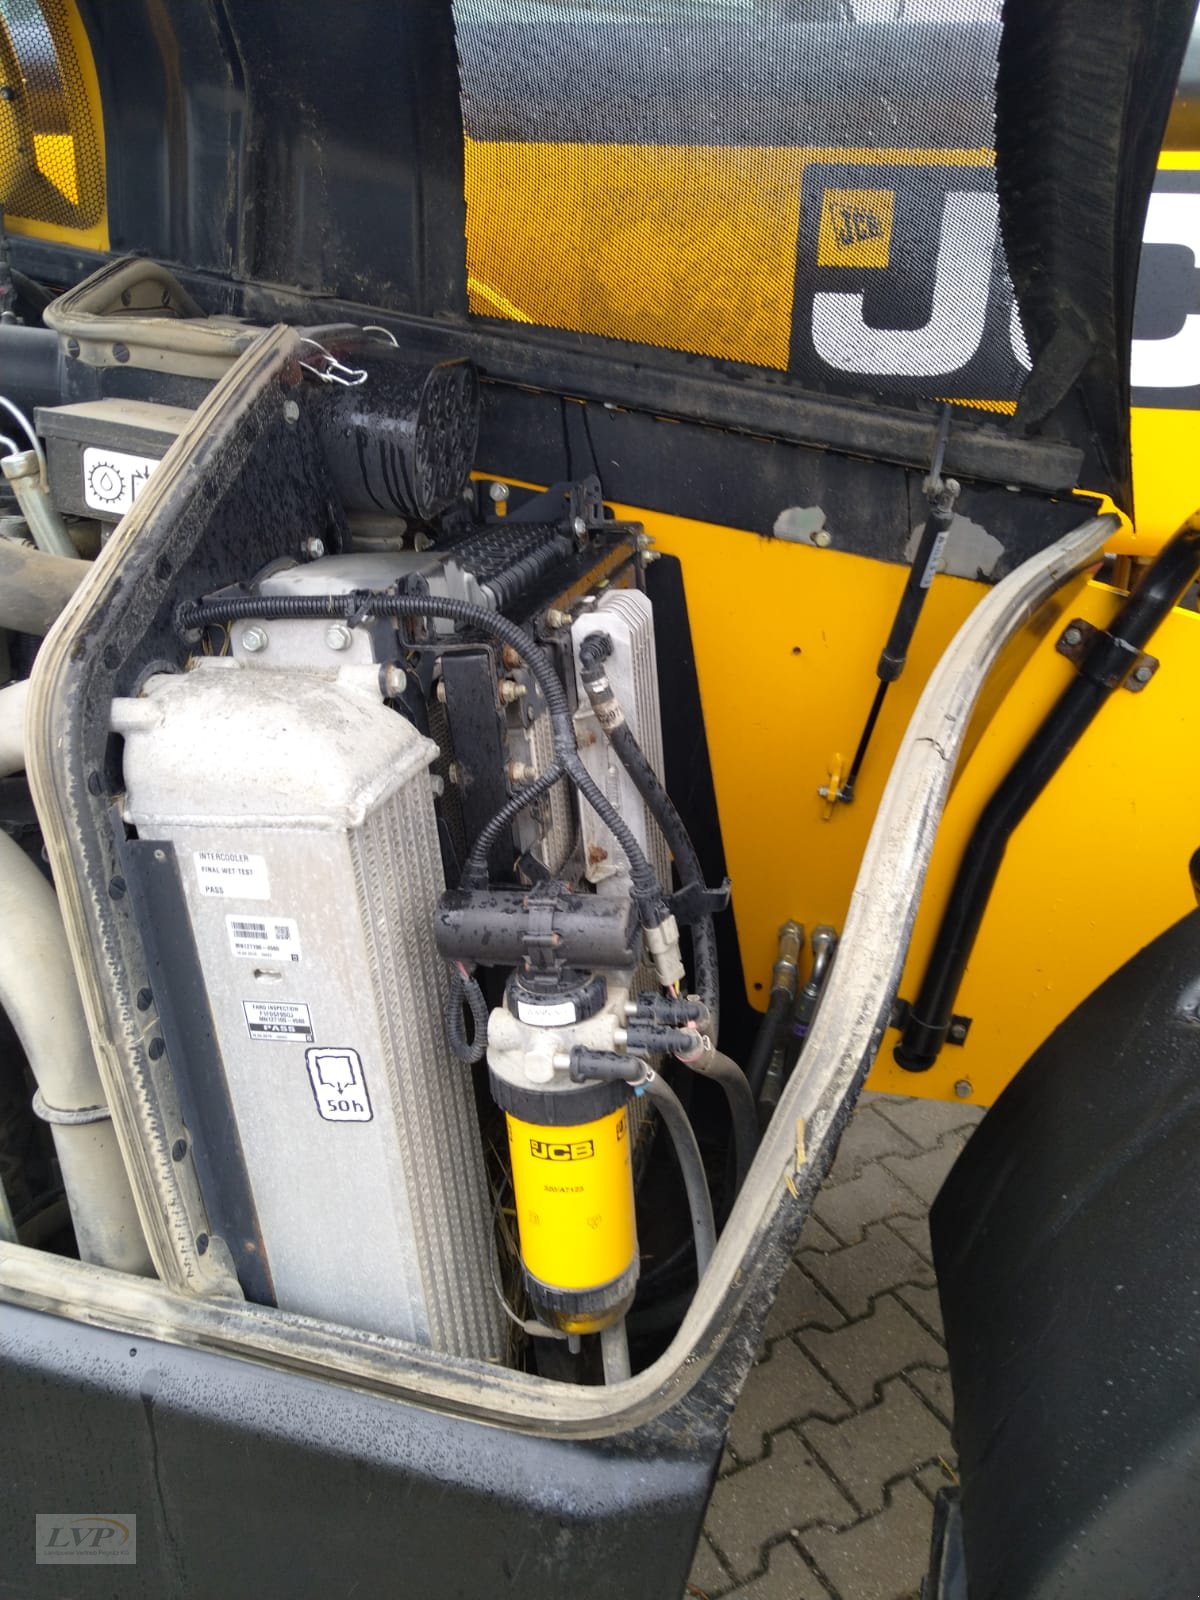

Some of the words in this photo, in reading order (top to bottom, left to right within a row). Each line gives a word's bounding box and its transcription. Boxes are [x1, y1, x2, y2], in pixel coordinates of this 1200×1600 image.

[199, 853, 249, 862] INTERCOOLER
[201, 866, 220, 874] FINAL
[205, 886, 224, 894] PASS
[263, 1024, 296, 1033] PASS
[531, 1141, 594, 1160] JCB
